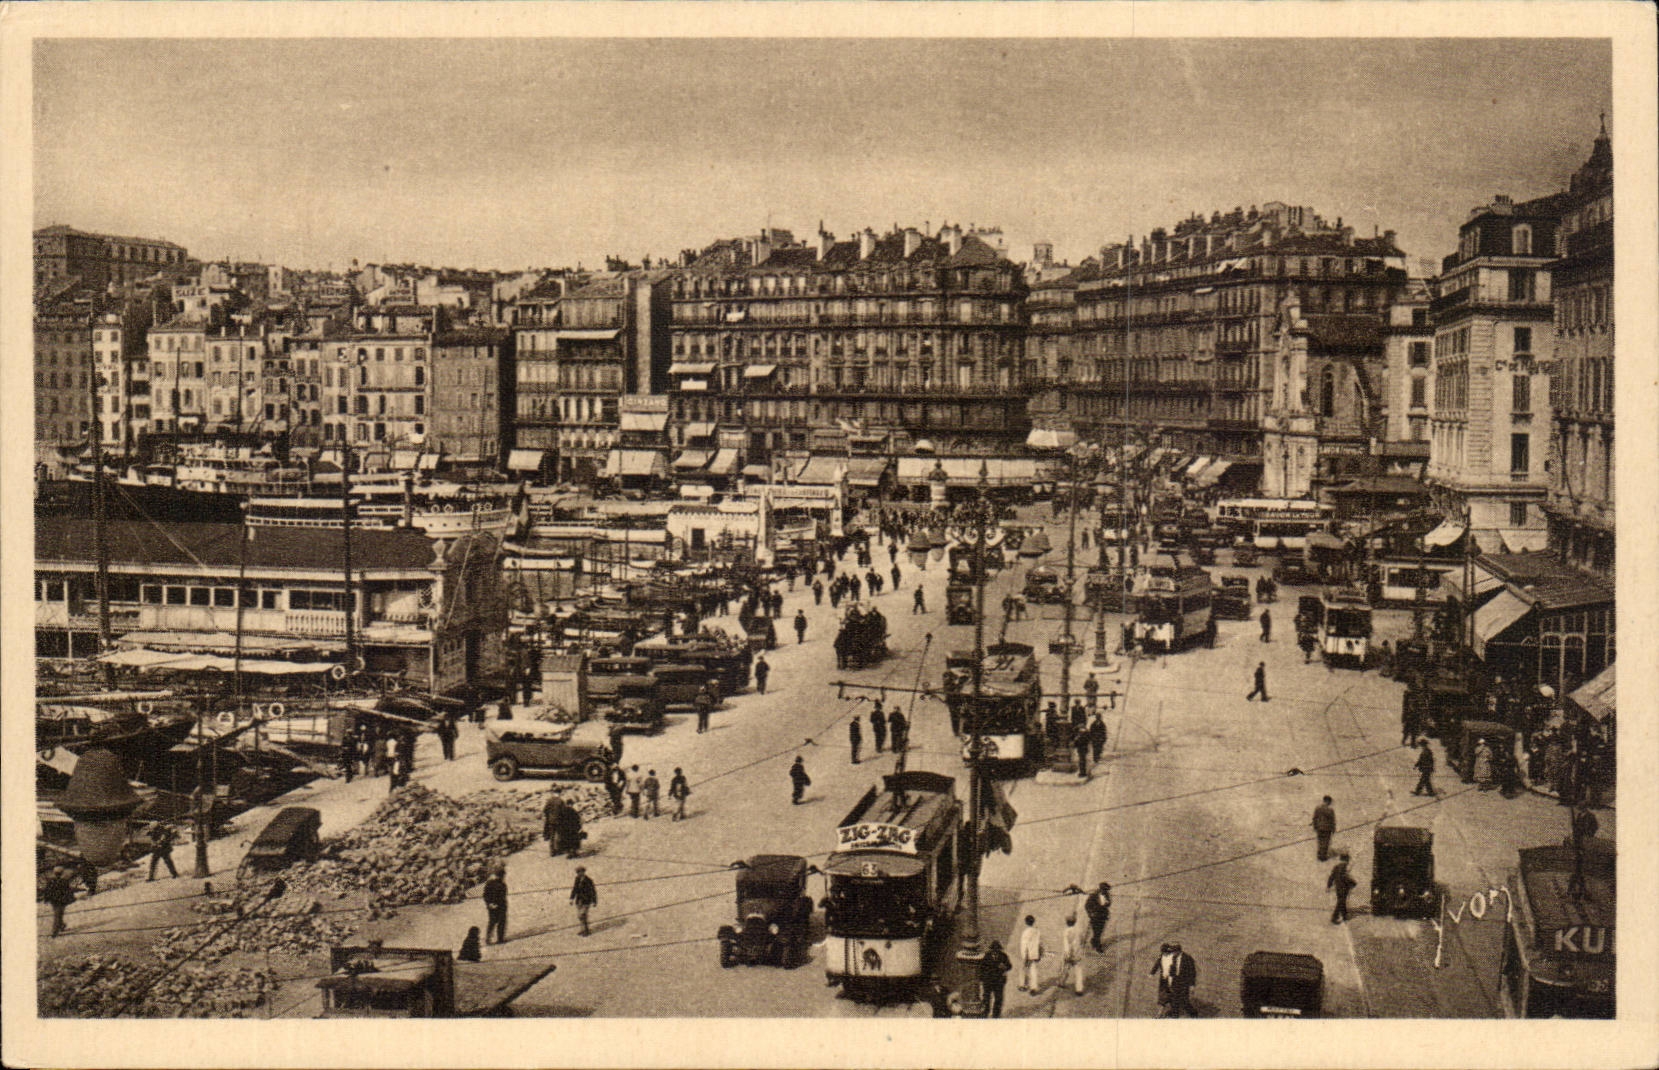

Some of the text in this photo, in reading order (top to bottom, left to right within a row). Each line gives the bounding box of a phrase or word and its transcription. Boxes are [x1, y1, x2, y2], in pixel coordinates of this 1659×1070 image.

[175, 287, 206, 297] SUZE
[627, 397, 668, 407] CINZANO
[839, 824, 911, 844] ZIG-ZAG
[1554, 926, 1617, 954] KU
